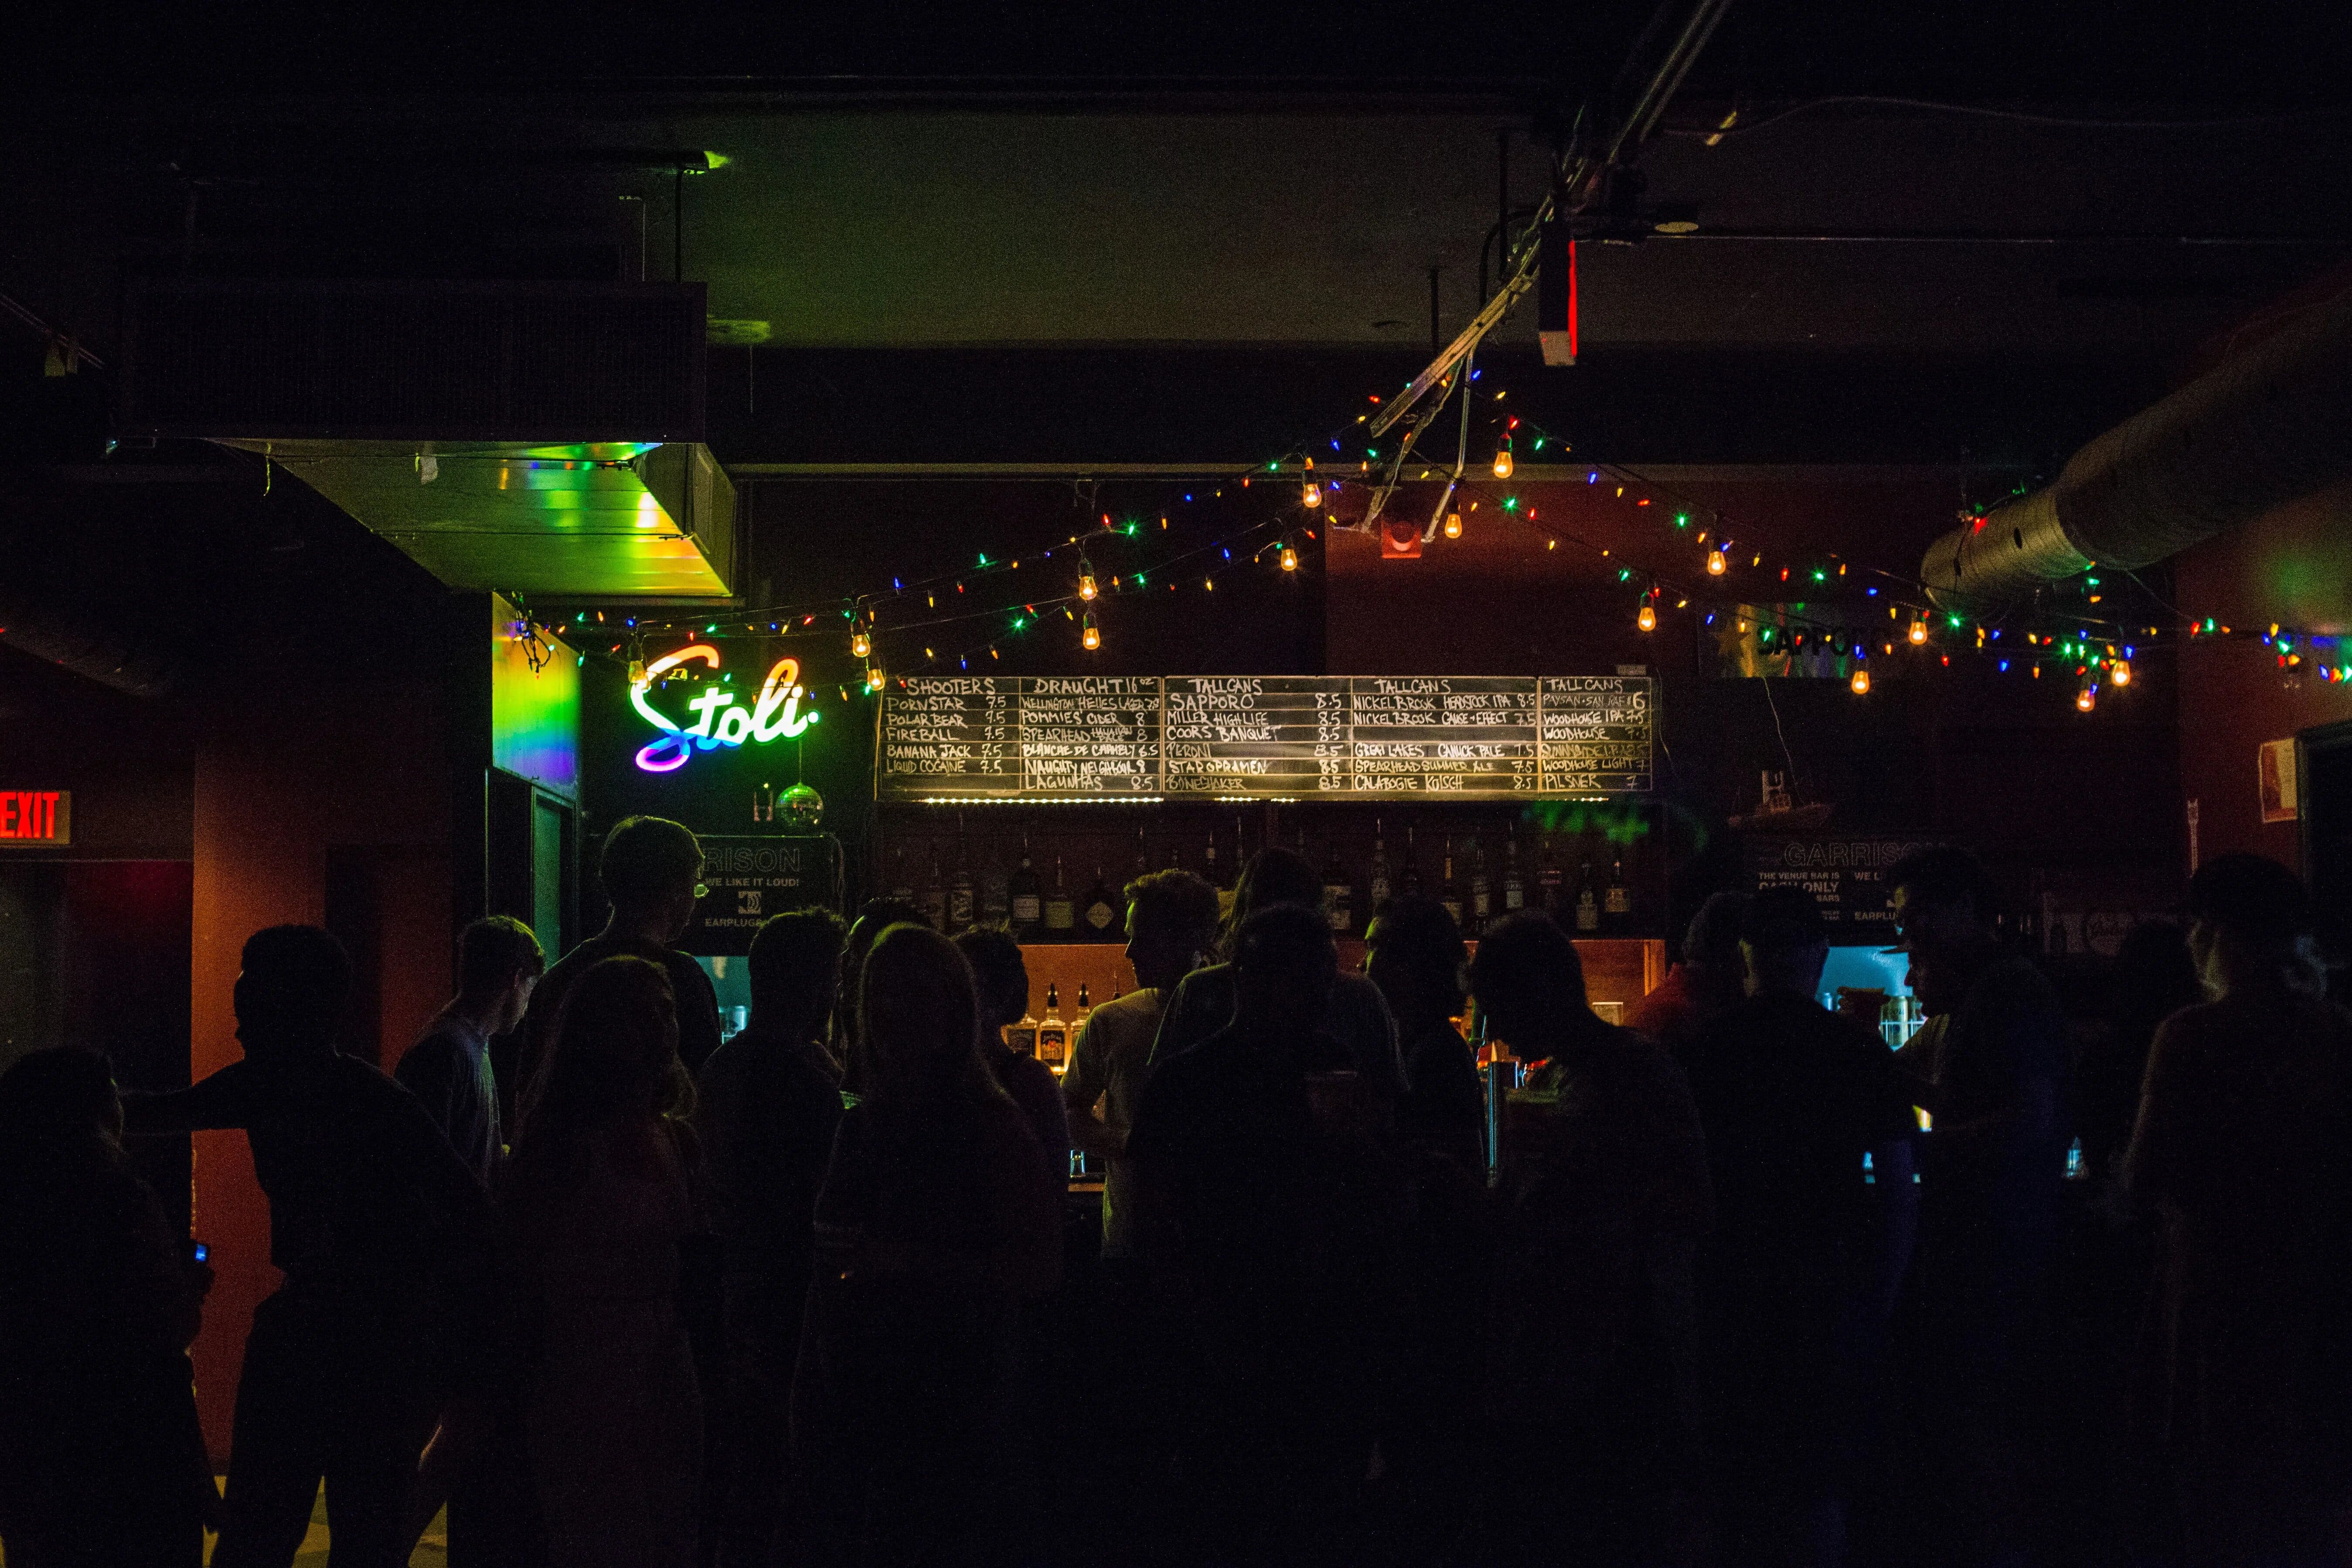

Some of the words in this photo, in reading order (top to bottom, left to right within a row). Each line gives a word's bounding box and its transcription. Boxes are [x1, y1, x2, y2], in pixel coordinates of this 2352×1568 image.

[907, 677, 996, 695] SHOOTERS
[1033, 678, 1123, 694] DRAUGHT
[986, 696, 1006, 709] 7.5
[1022, 697, 1074, 710] WELLINGTON
[1170, 693, 1254, 711] SAPPORO
[1315, 693, 1341, 709] 8.5
[1493, 695, 1511, 708] IPA
[1517, 694, 1535, 707] 8.5
[886, 713, 932, 726] POLAR
[930, 713, 967, 728] BEAR
[986, 711, 1005, 724] 7.5
[1086, 712, 1125, 726] CIDER
[1136, 712, 1144, 727] 8
[1166, 711, 1214, 727] MILLER
[1318, 711, 1341, 726] 8.5
[1514, 713, 1536, 726] 7.5
[1606, 710, 1624, 723] IPA
[886, 728, 960, 741] FIREBALL
[985, 727, 1004, 740] 7.5
[1022, 728, 1090, 742] SPEARHEAD
[1137, 728, 1147, 741] 8
[1166, 726, 1212, 740] COORS
[1215, 725, 1282, 742] BANQUET
[1318, 727, 1341, 741] 8.5
[1543, 727, 1610, 740] WOODHOUSE
[887, 745, 936, 758] BANANA
[939, 744, 971, 757] JACK
[982, 743, 1002, 759] 7.5
[1022, 743, 1072, 757] BLANCHE
[1074, 745, 1089, 756] DE
[1166, 742, 1212, 758] PERONI
[1314, 744, 1343, 757] 8.5
[1388, 744, 1424, 757] LAKES
[1438, 743, 1476, 758] CANUCK
[1475, 744, 1505, 757] PALE
[887, 759, 916, 773] LIQUID
[920, 759, 966, 773] COCAINE
[980, 760, 1002, 775] 7.5
[1025, 759, 1077, 776] NAUGHTY
[1319, 759, 1341, 775] 8.5
[1355, 759, 1421, 773] SPEARHEAD
[1422, 760, 1471, 772] SUMMER
[1511, 760, 1535, 773] 7.5
[1025, 775, 1103, 791] LAGUNITAS
[1131, 775, 1153, 791] 8.5
[1318, 775, 1342, 791] 8.5
[1513, 775, 1532, 790] 8.5
[1542, 774, 1601, 790] PILSNER
[0, 792, 59, 839] EXIT
[705, 878, 722, 887] WE
[725, 878, 749, 887] LIKE
[753, 878, 763, 887] IT
[766, 878, 799, 887] LOUD!
[1854, 871, 1871, 881] WE
